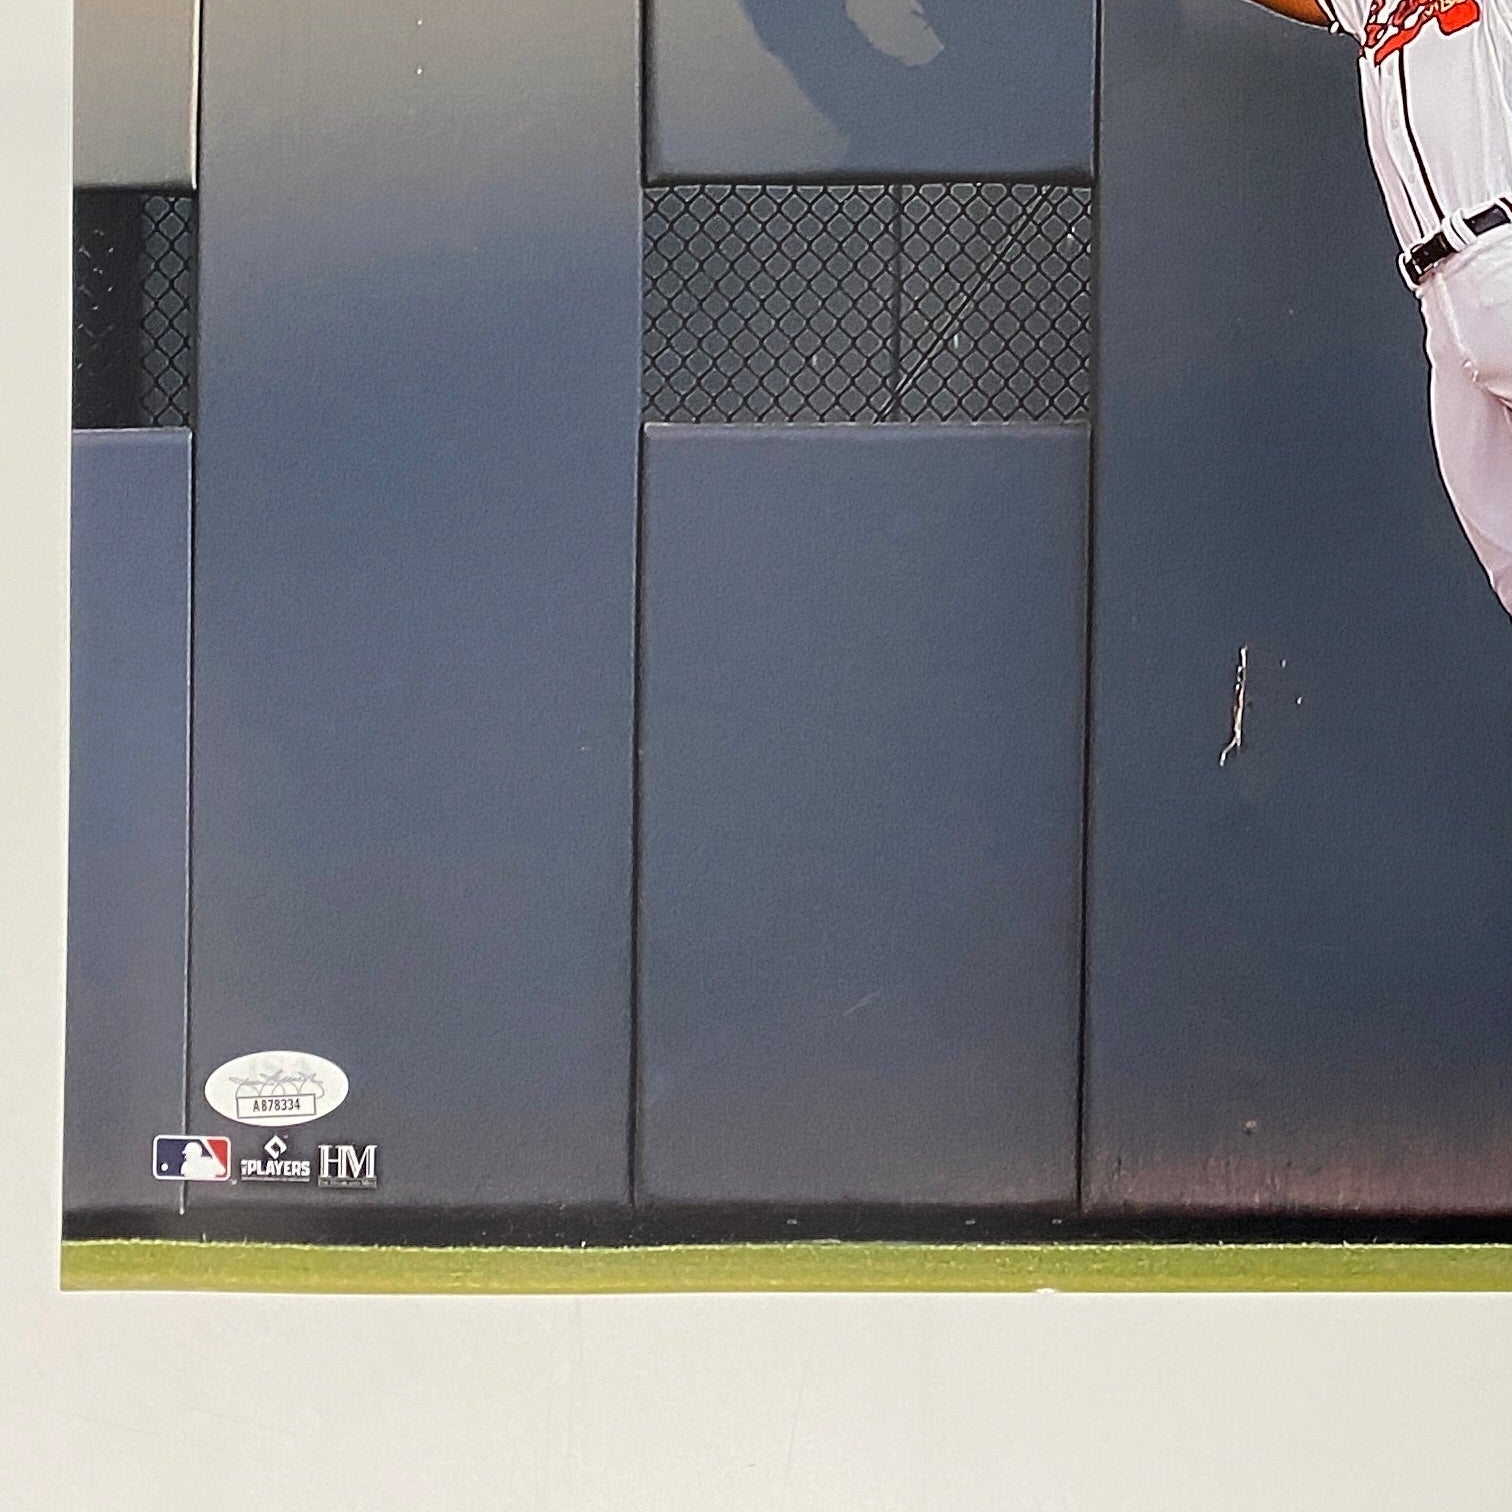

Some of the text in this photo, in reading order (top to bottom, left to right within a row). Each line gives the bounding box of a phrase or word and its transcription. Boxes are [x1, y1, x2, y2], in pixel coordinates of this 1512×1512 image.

[252, 1098, 301, 1112] AB78334
[247, 1159, 311, 1177] PLAYERS
[317, 1144, 378, 1178] HM
